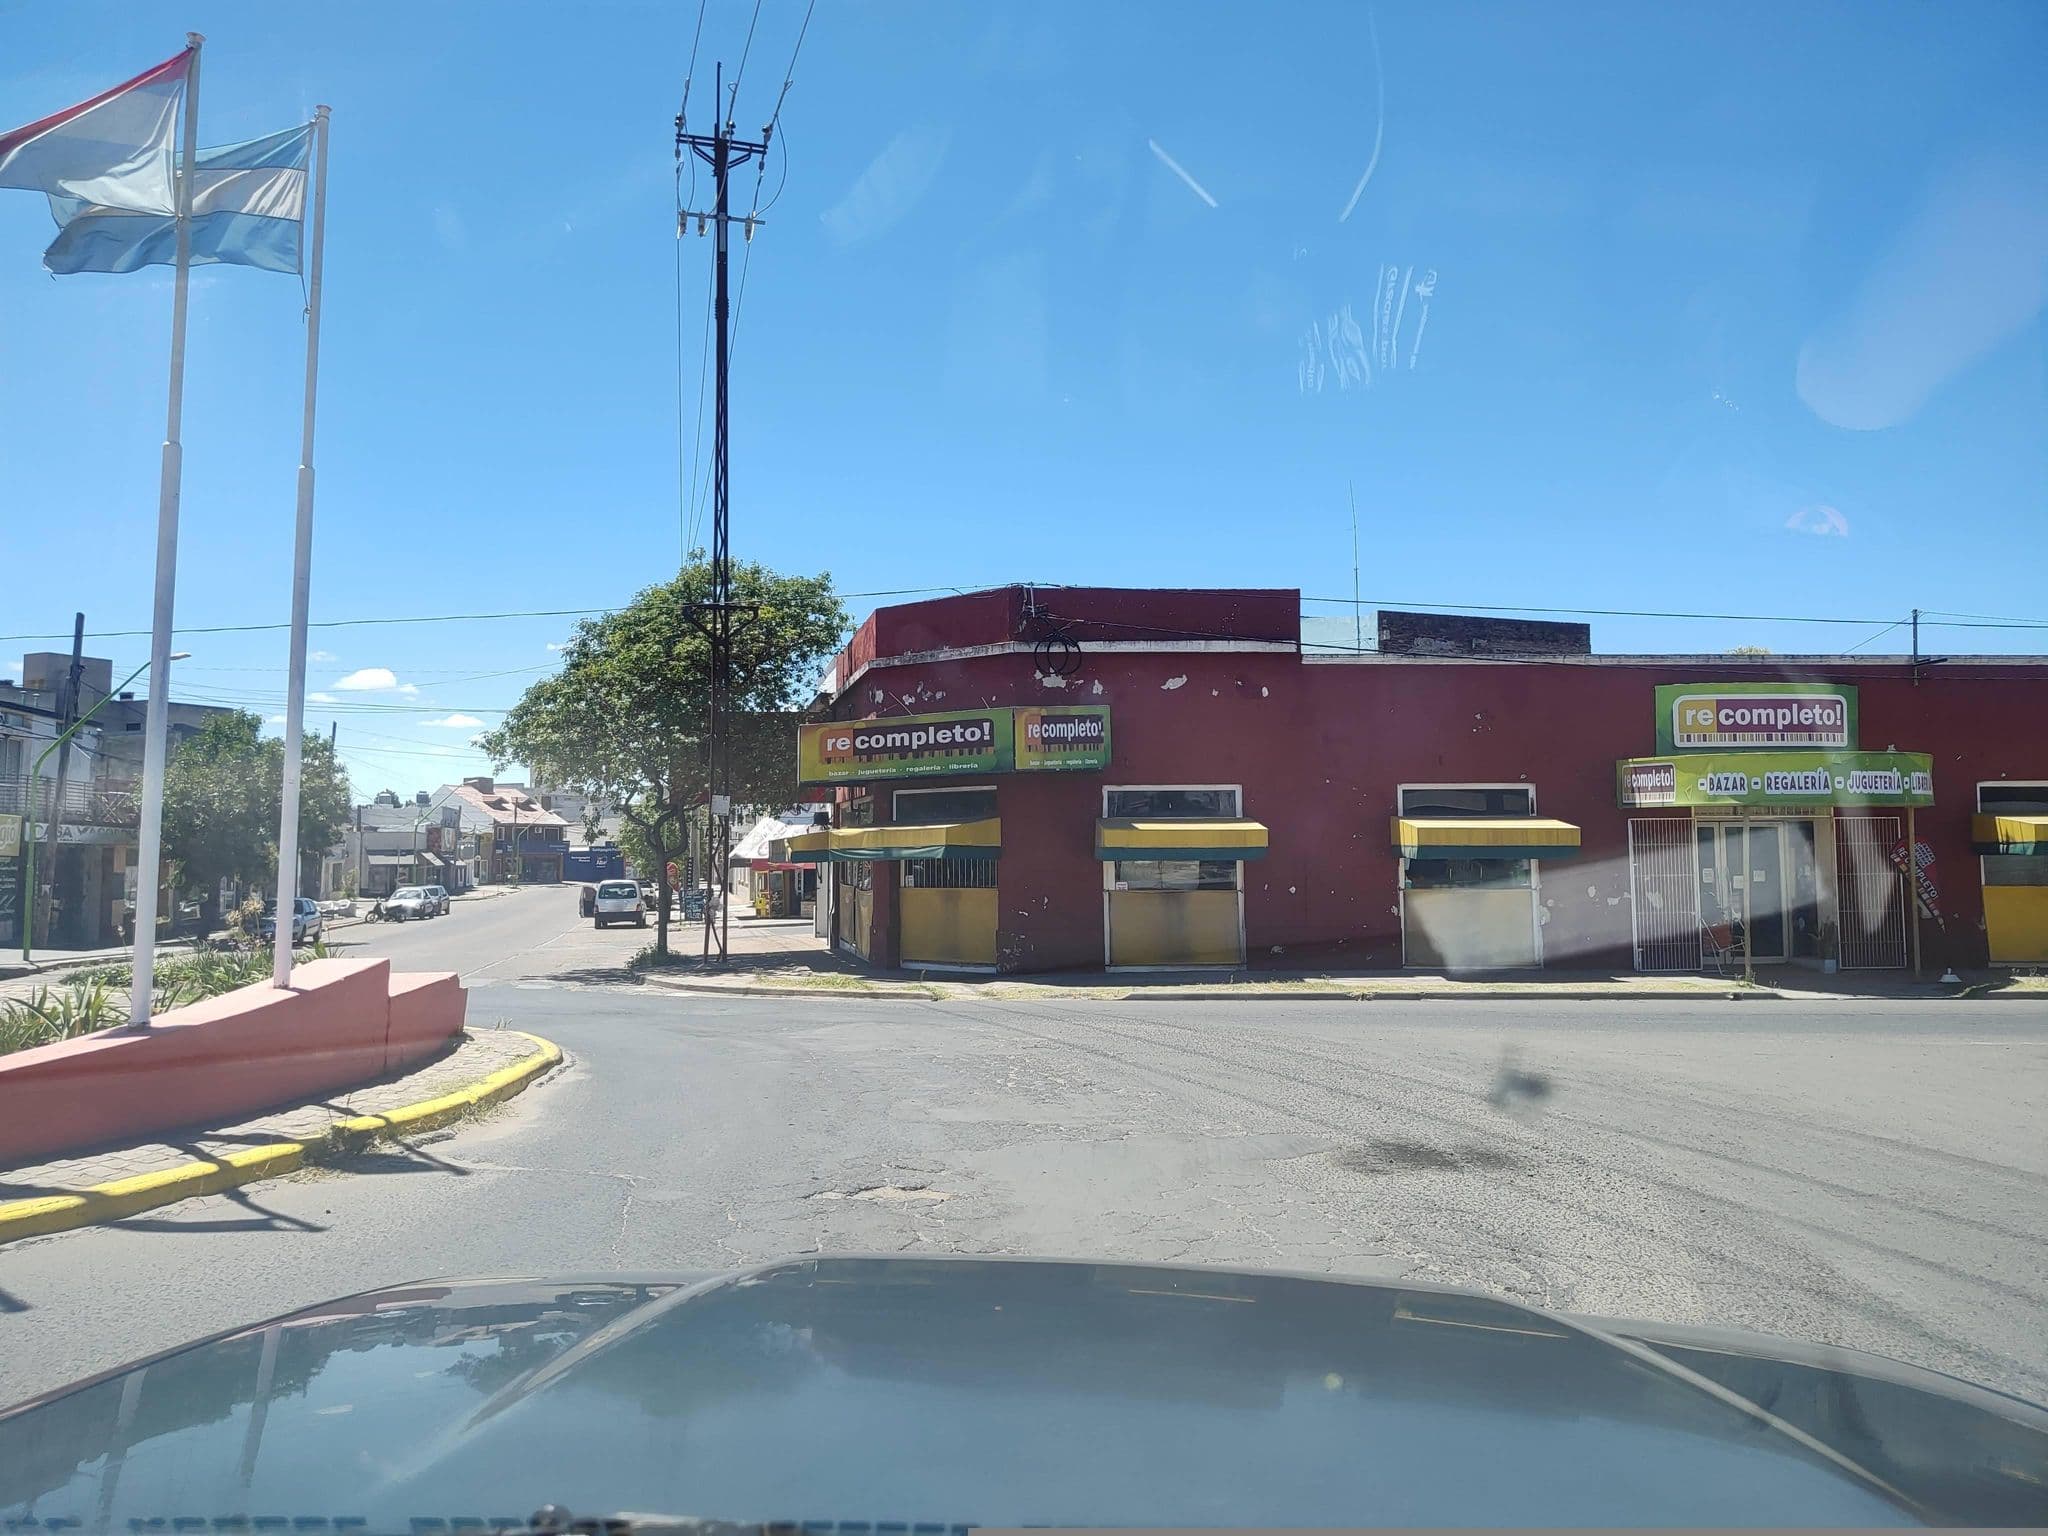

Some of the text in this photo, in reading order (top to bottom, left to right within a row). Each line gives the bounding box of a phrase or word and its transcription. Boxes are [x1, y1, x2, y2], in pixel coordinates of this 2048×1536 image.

[1708, 776, 1746, 792] BAZAR
[1766, 769, 1830, 791] REGALERÍA
[1848, 769, 1902, 790] JUGUETERÍA
